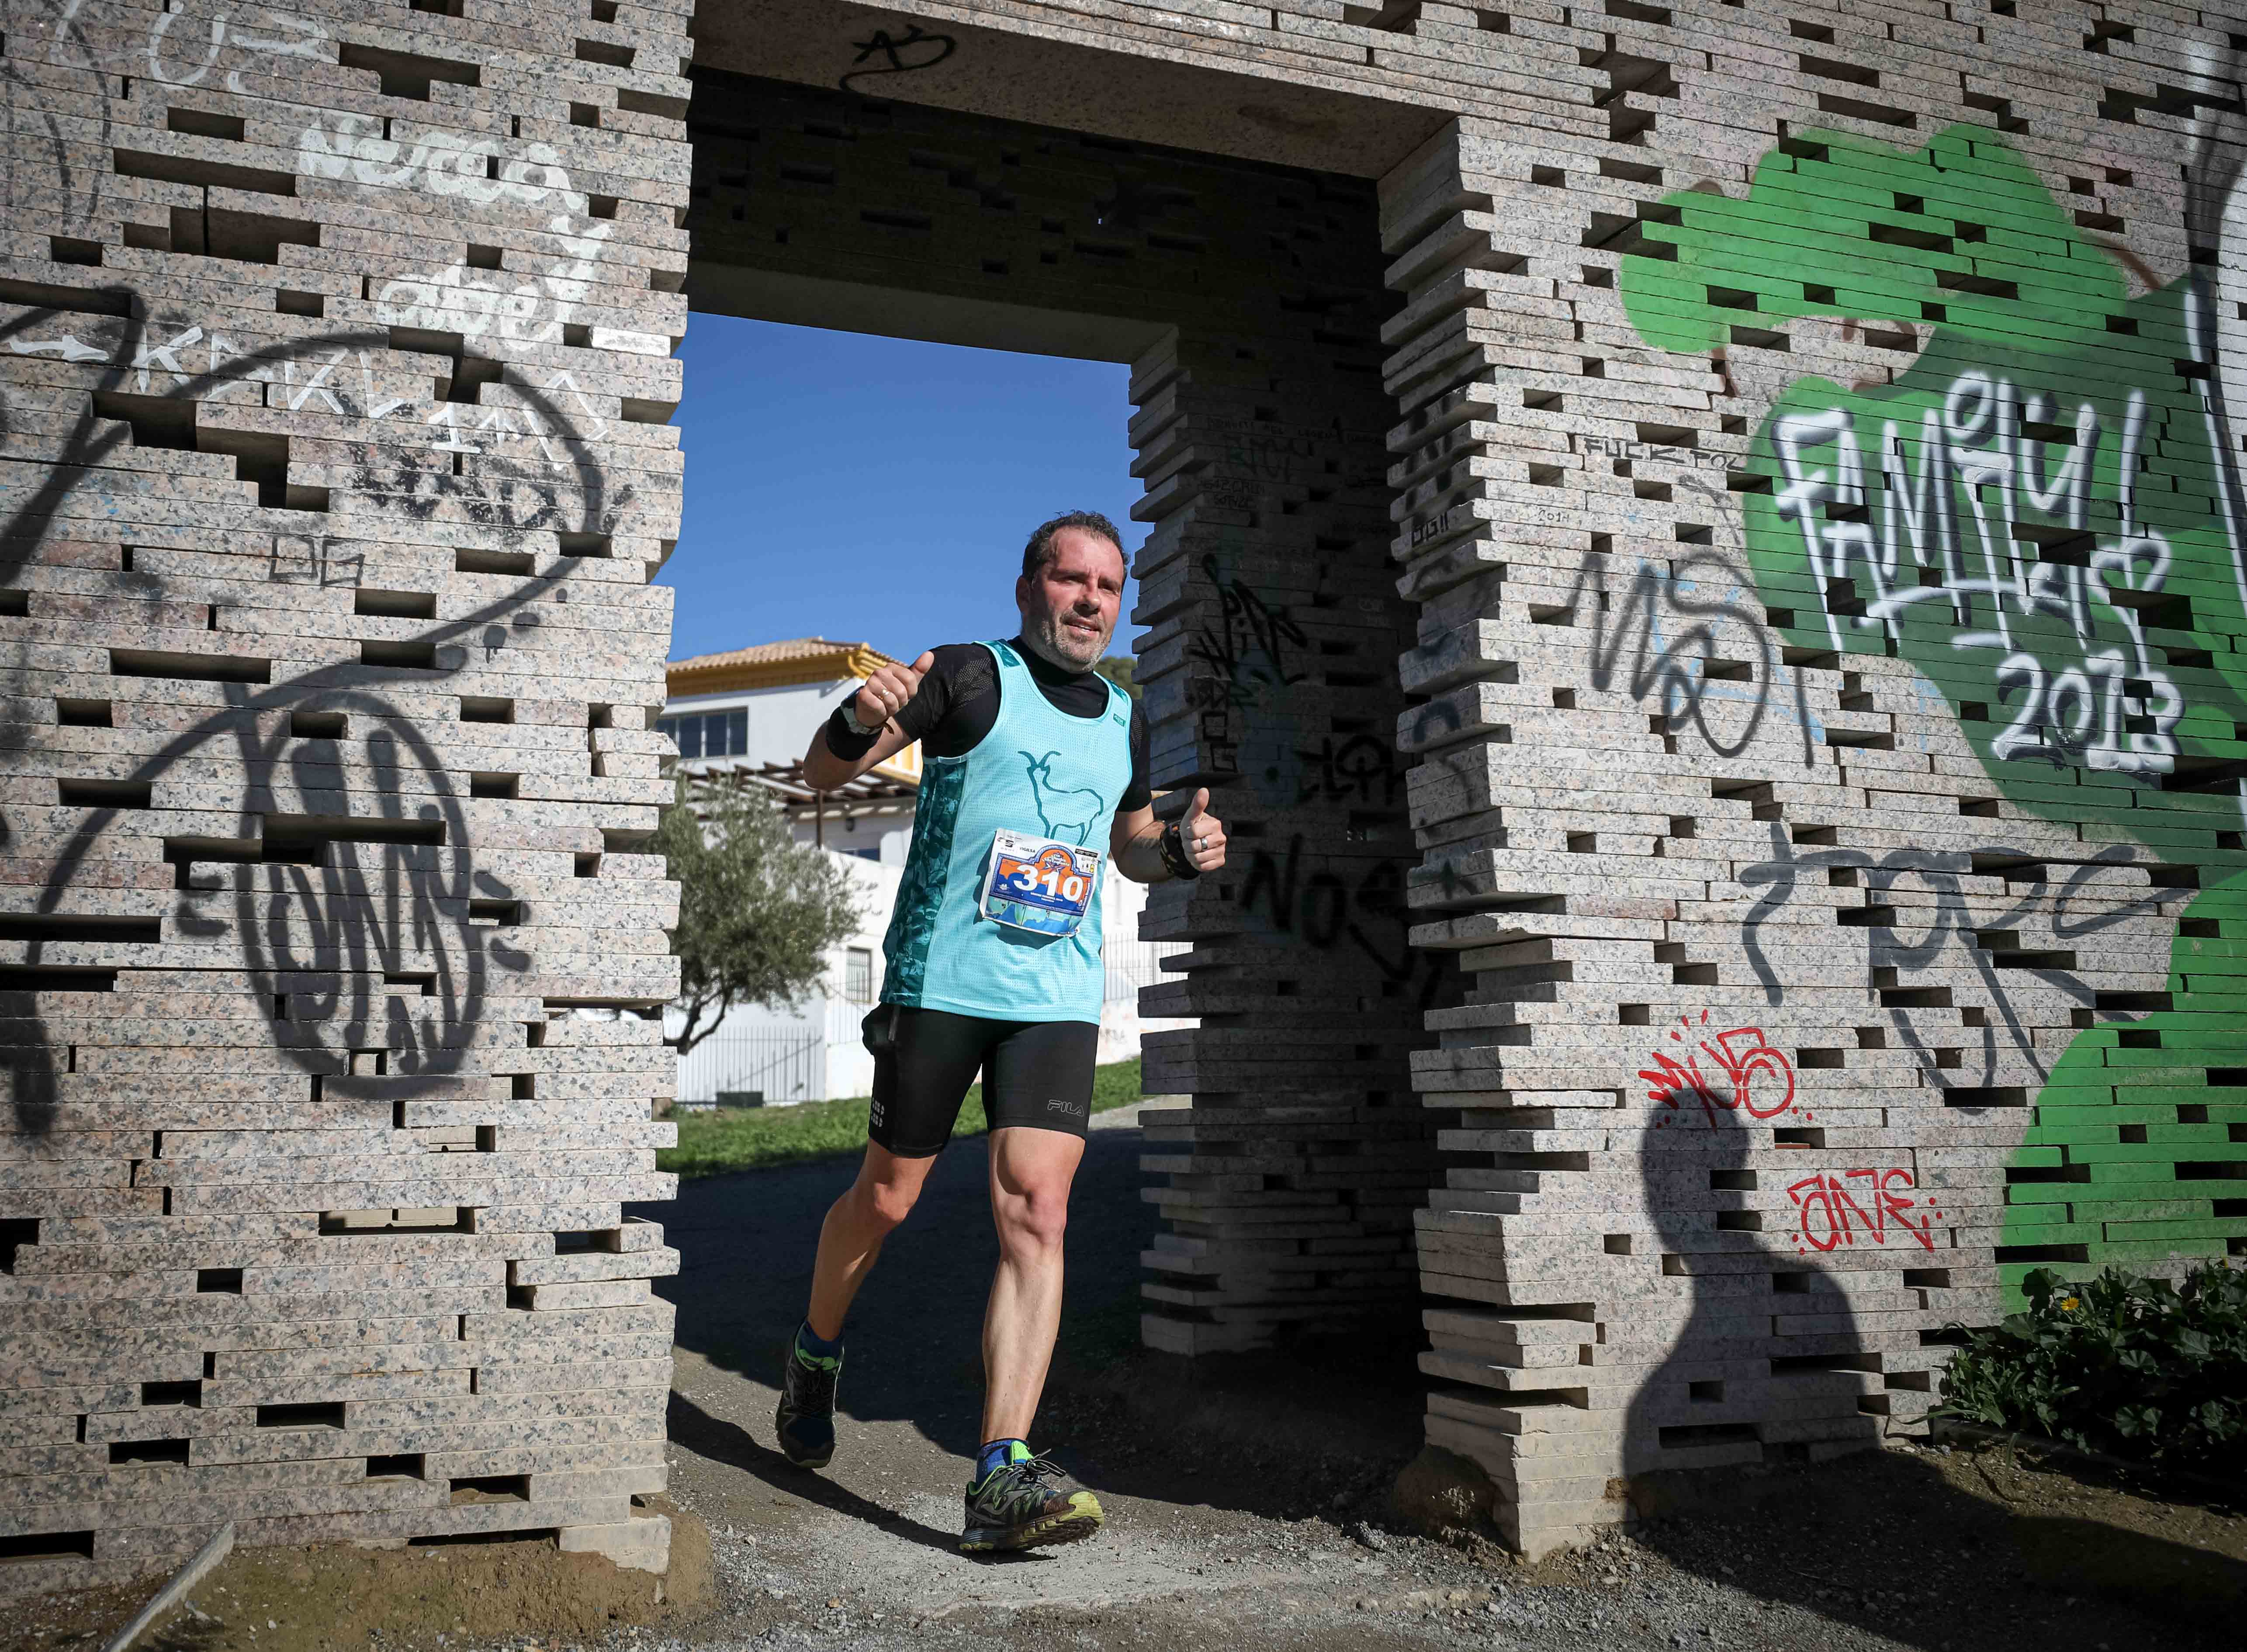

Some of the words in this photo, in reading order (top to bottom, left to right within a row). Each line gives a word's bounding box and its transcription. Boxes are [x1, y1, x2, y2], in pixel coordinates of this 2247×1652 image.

[1583, 437, 1685, 464] FUCK
[1013, 864, 1084, 902] 310
[1047, 1099, 1084, 1117] FILA
